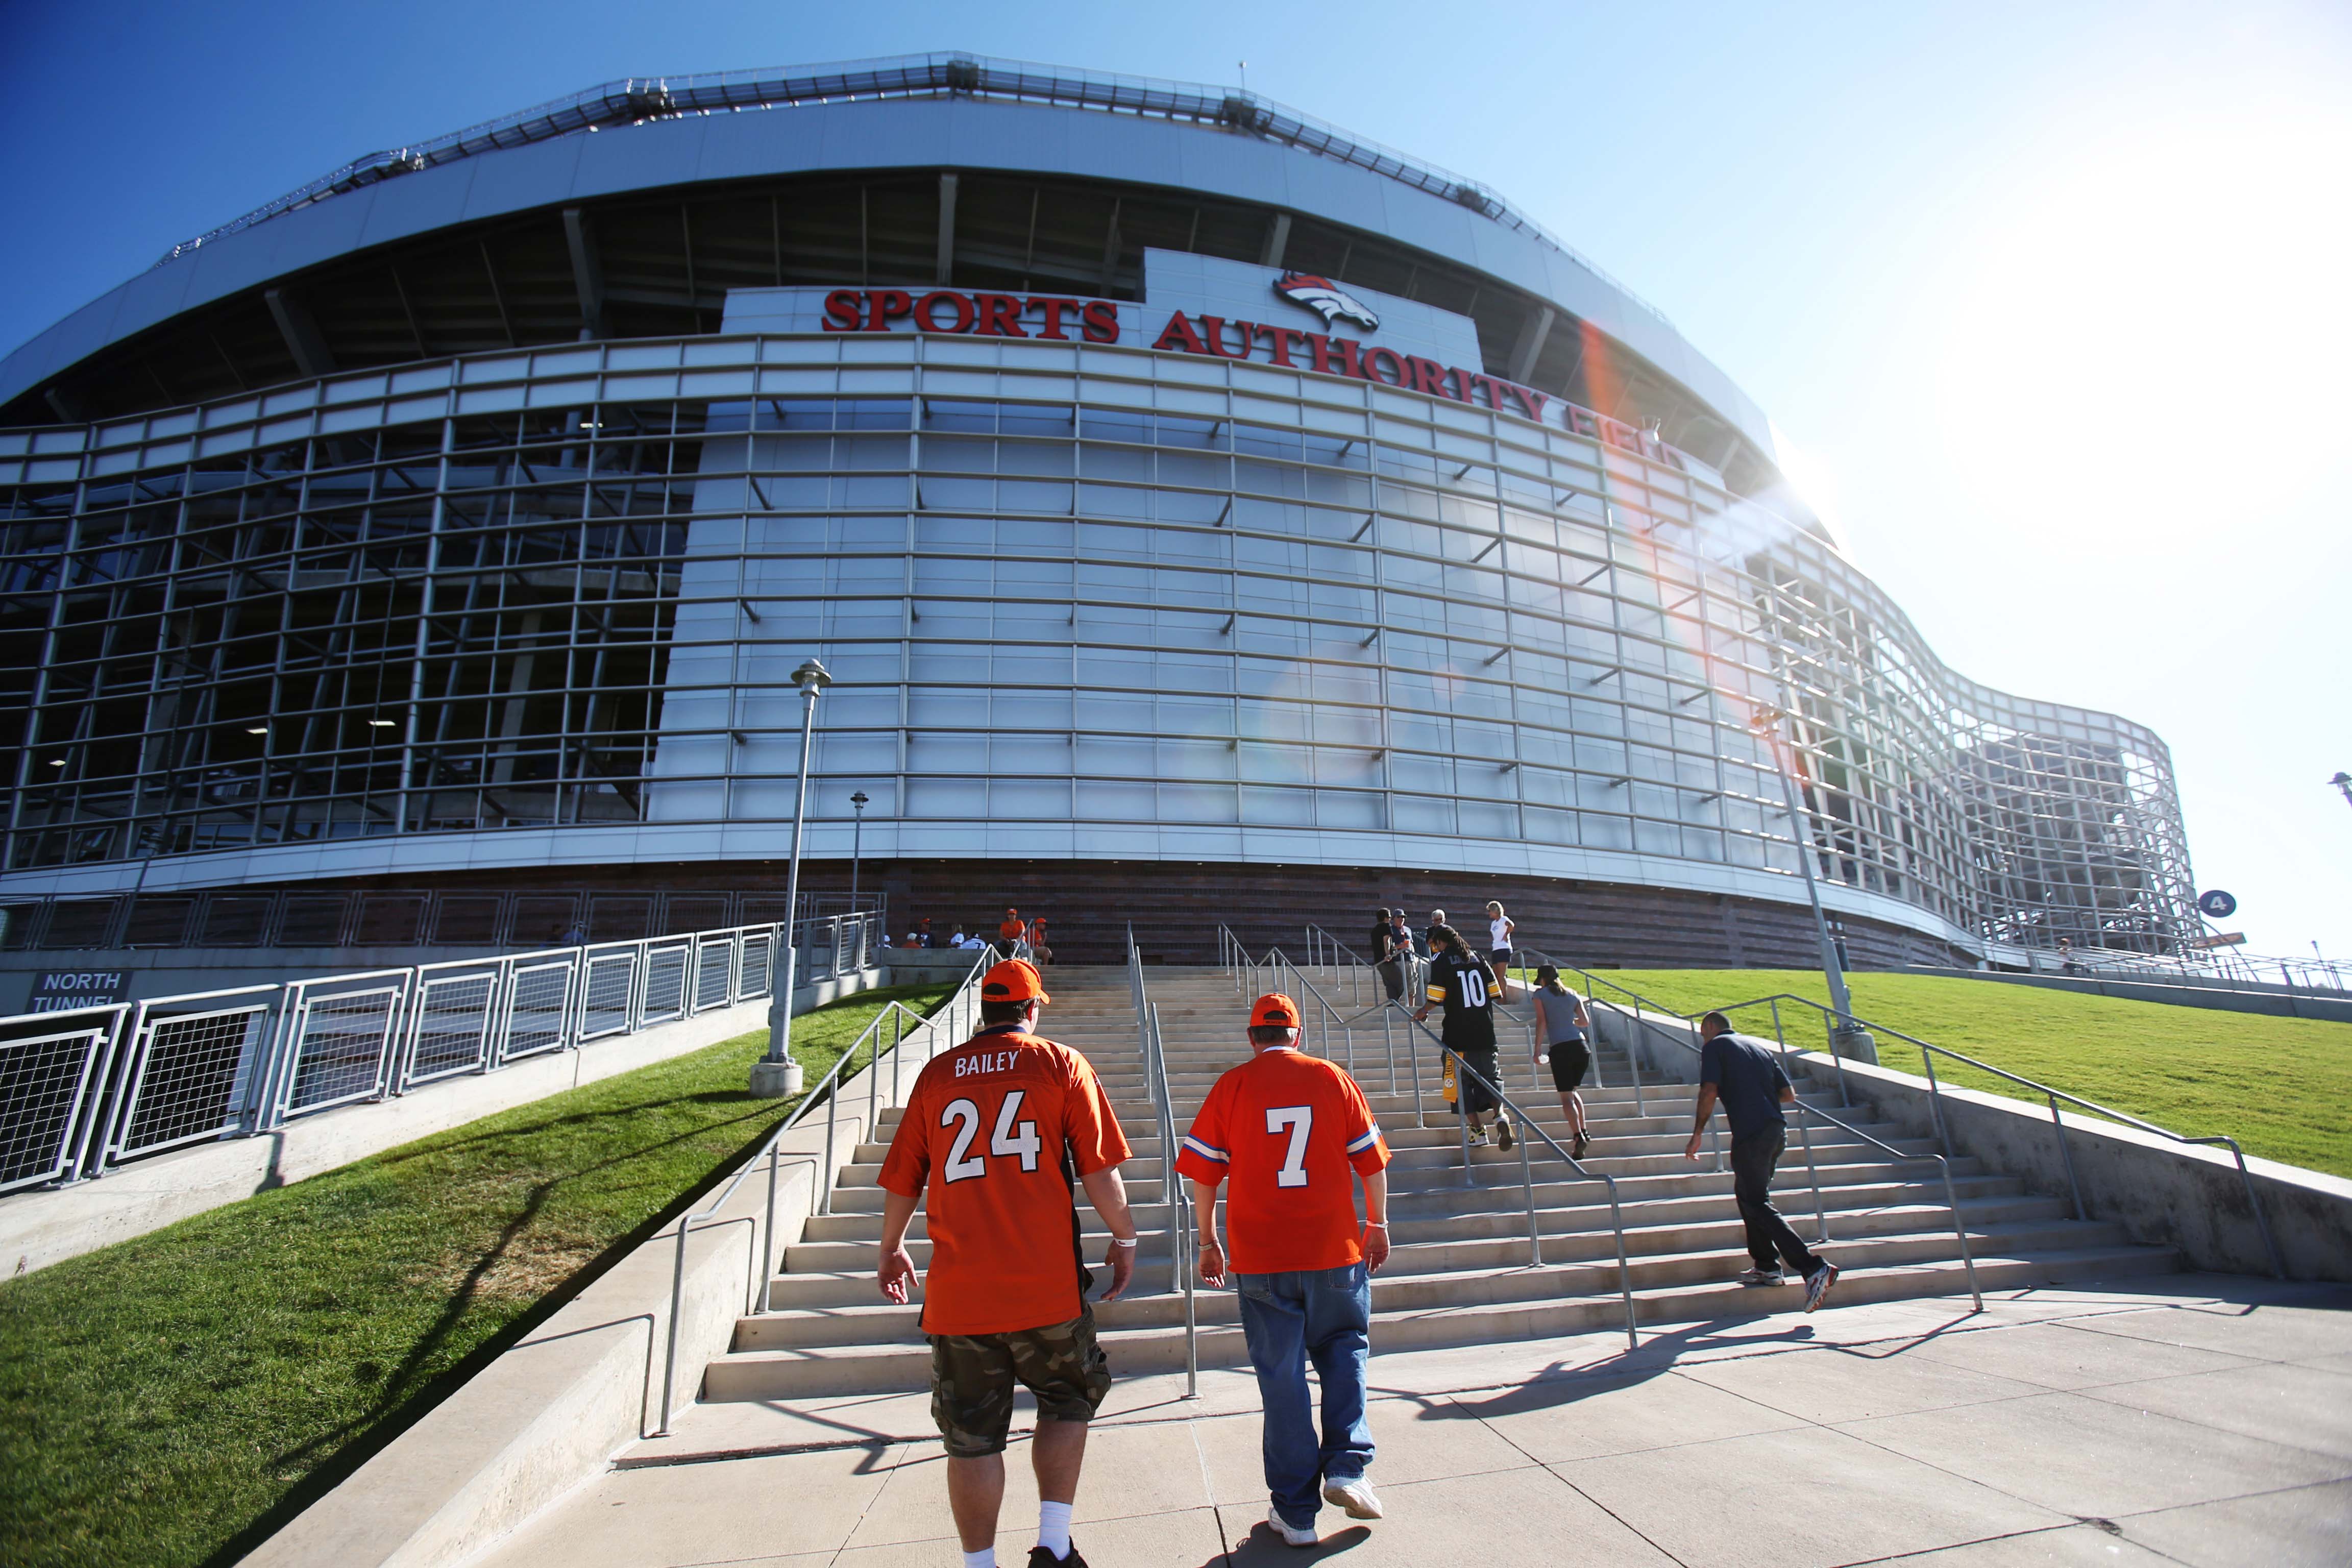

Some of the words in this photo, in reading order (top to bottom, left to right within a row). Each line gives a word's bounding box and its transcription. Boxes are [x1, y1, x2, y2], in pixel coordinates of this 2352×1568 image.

[821, 289, 1120, 344] SPORTS
[1152, 309, 1549, 423] AUTHORITY
[2210, 896, 2227, 911] 4
[44, 973, 121, 990] NORTH
[1456, 969, 1486, 1008] 10
[955, 1049, 1021, 1078] BAILEY
[940, 1089, 1042, 1185] 24
[1265, 1105, 1313, 1189] 7
